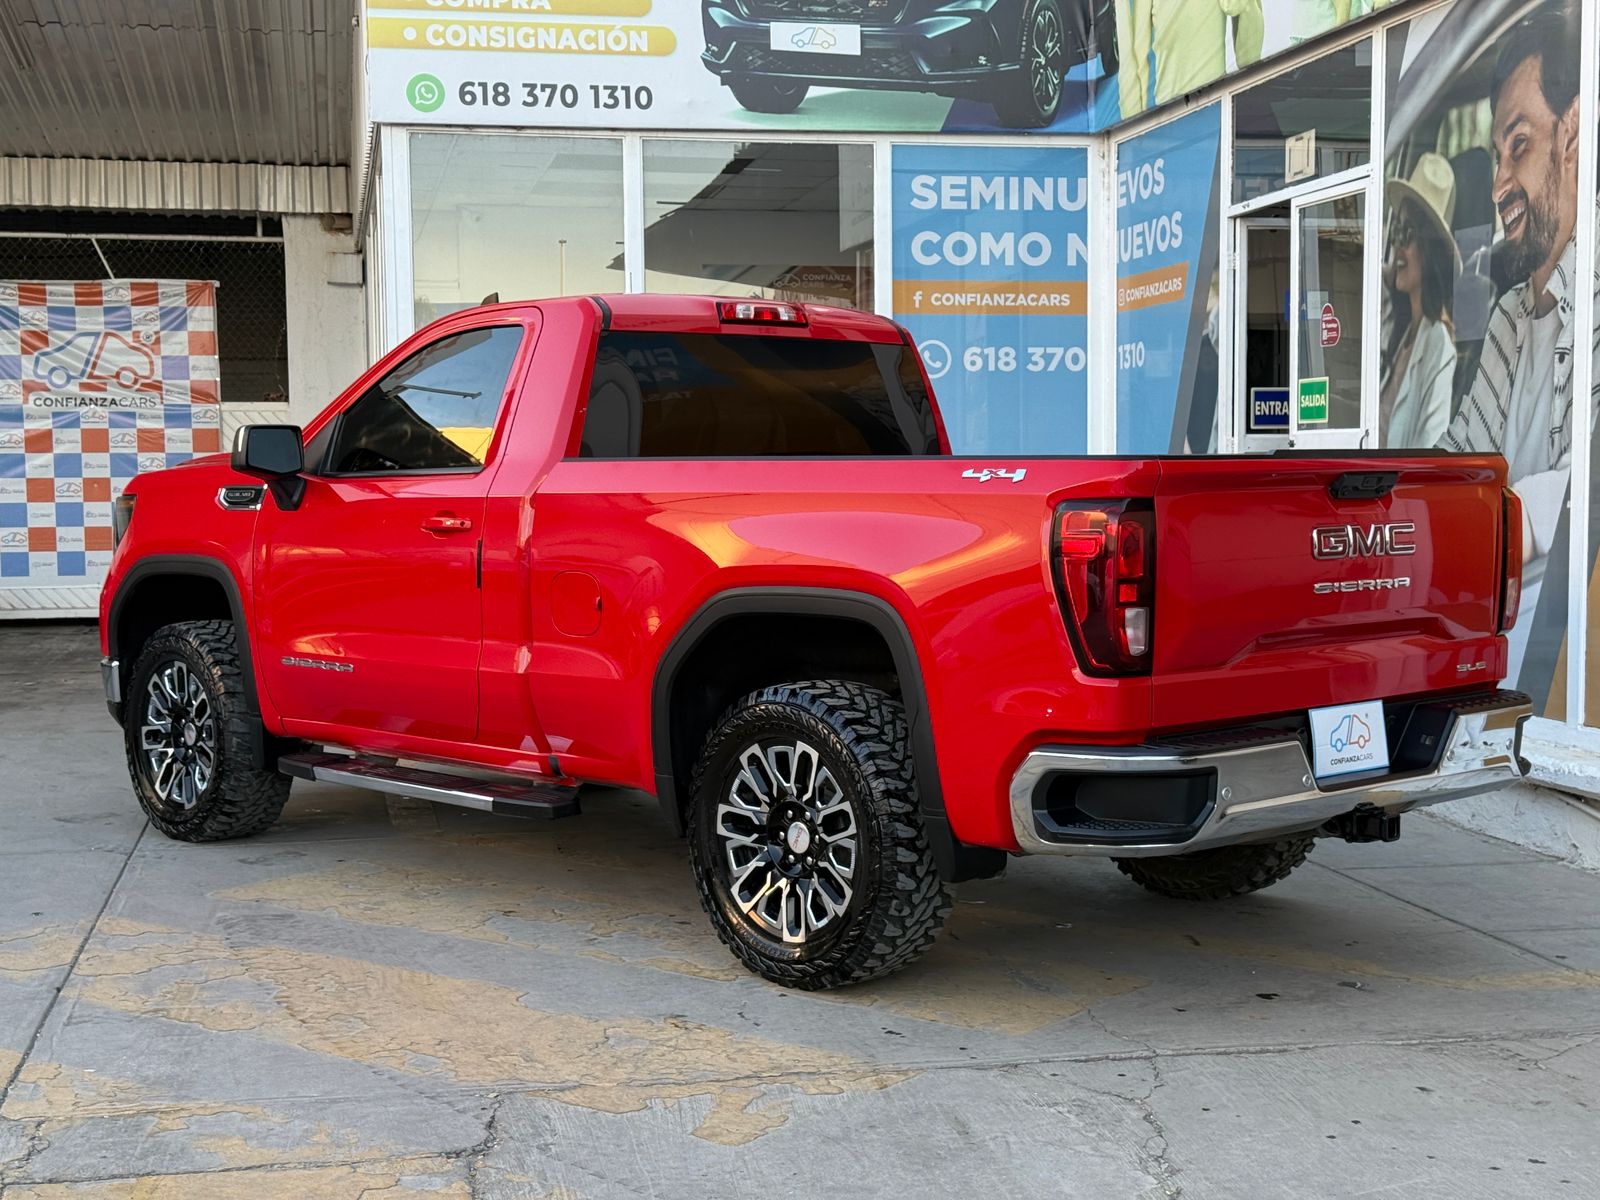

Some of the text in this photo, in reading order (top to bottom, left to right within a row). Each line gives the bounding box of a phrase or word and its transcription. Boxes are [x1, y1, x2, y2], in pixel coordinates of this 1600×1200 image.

[425, 23, 649, 52] CONSIGNACIÓN
[458, 81, 654, 110] 618 370 1310
[910, 174, 1088, 212] SEMINU
[910, 231, 1052, 267] COMO
[930, 293, 1071, 307] CONFIANZACARS
[1125, 277, 1183, 302] CONFIANZACARS
[962, 347, 1087, 372] 618 370
[1118, 341, 1145, 370] 1310
[33, 396, 157, 408] CONFIANZACARS
[1255, 401, 1289, 416] ENTRA
[1301, 393, 1326, 408] SALIDA
[1312, 522, 1416, 560] GMC
[1313, 577, 1411, 594] SIERRA
[1330, 752, 1374, 766] CONFIANZACARS
